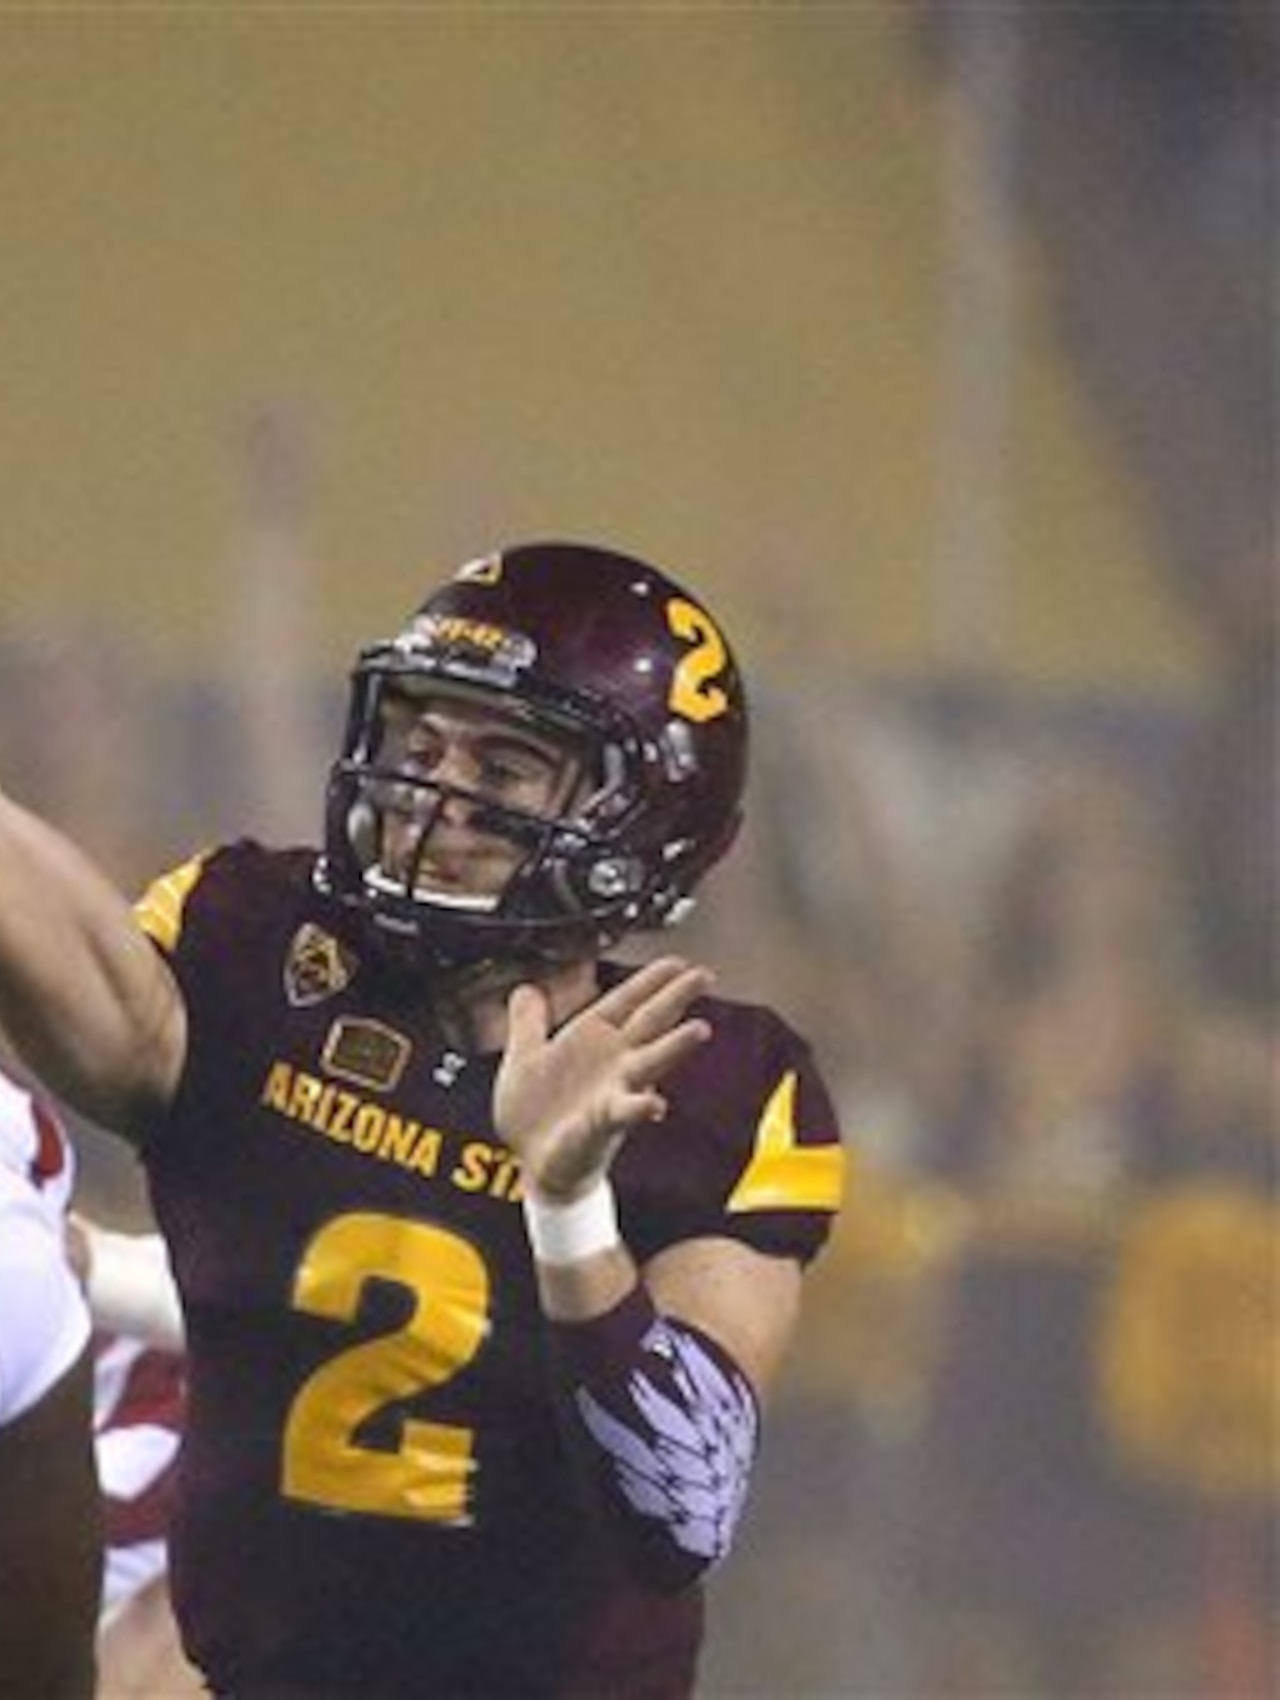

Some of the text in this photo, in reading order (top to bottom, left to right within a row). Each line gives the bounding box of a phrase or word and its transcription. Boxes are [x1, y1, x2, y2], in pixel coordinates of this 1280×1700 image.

[665, 596, 728, 723] 2
[261, 1060, 443, 1178] ARIZONA
[280, 1211, 492, 1526] 2
